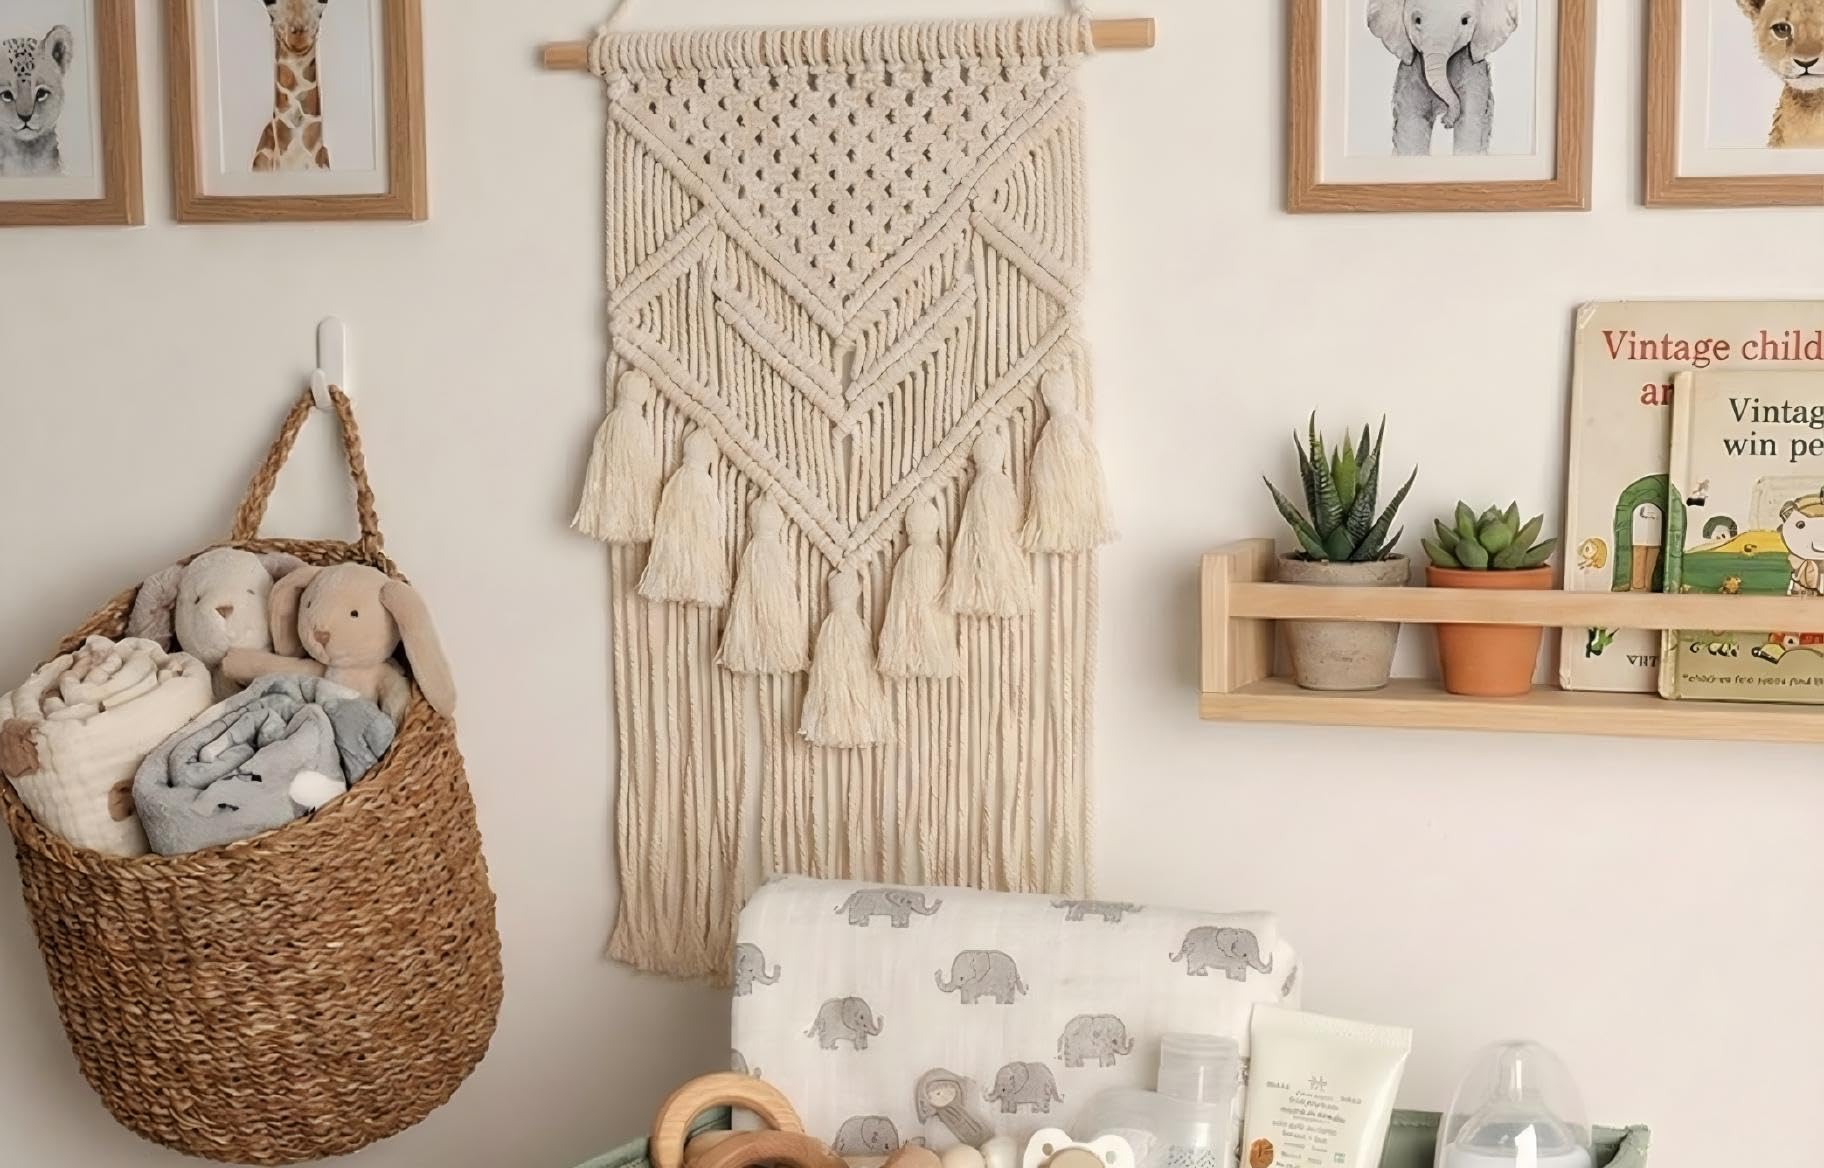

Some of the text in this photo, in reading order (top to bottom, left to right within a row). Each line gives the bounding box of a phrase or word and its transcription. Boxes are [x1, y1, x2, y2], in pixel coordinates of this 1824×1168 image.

[1602, 330, 1824, 368] Vintage child
[1728, 397, 1824, 430] Vintag
[1723, 430, 1824, 463] win pe
